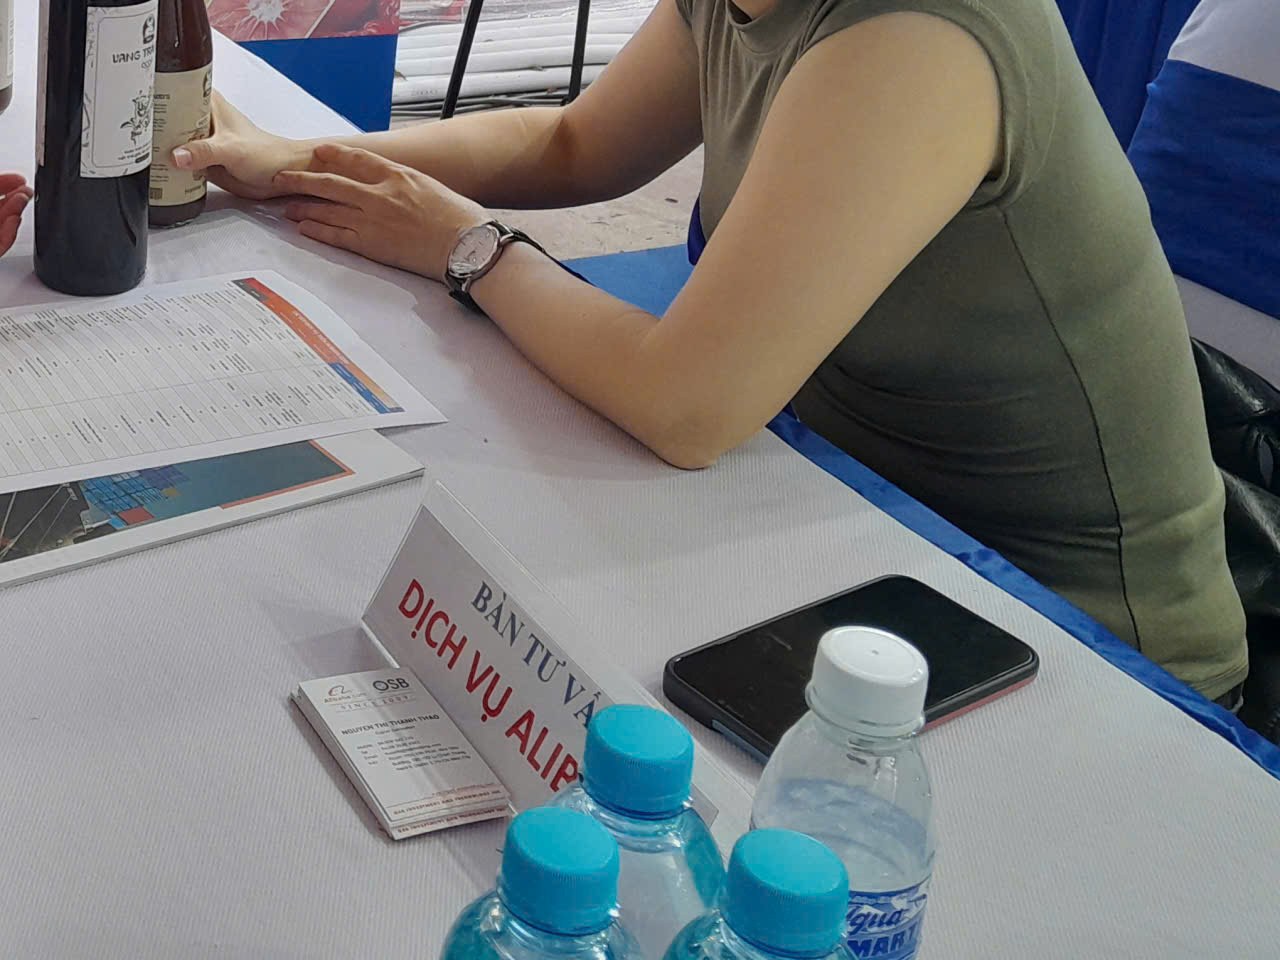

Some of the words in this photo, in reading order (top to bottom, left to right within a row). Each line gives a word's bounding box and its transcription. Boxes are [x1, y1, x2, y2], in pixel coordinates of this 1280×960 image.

[373, 678, 410, 691] OSB
[398, 579, 468, 670] DỊCH
[465, 649, 513, 723] VỤ
[471, 581, 526, 647] BÀN
[523, 632, 567, 683] TƯ
[563, 672, 602, 730] VẤ
